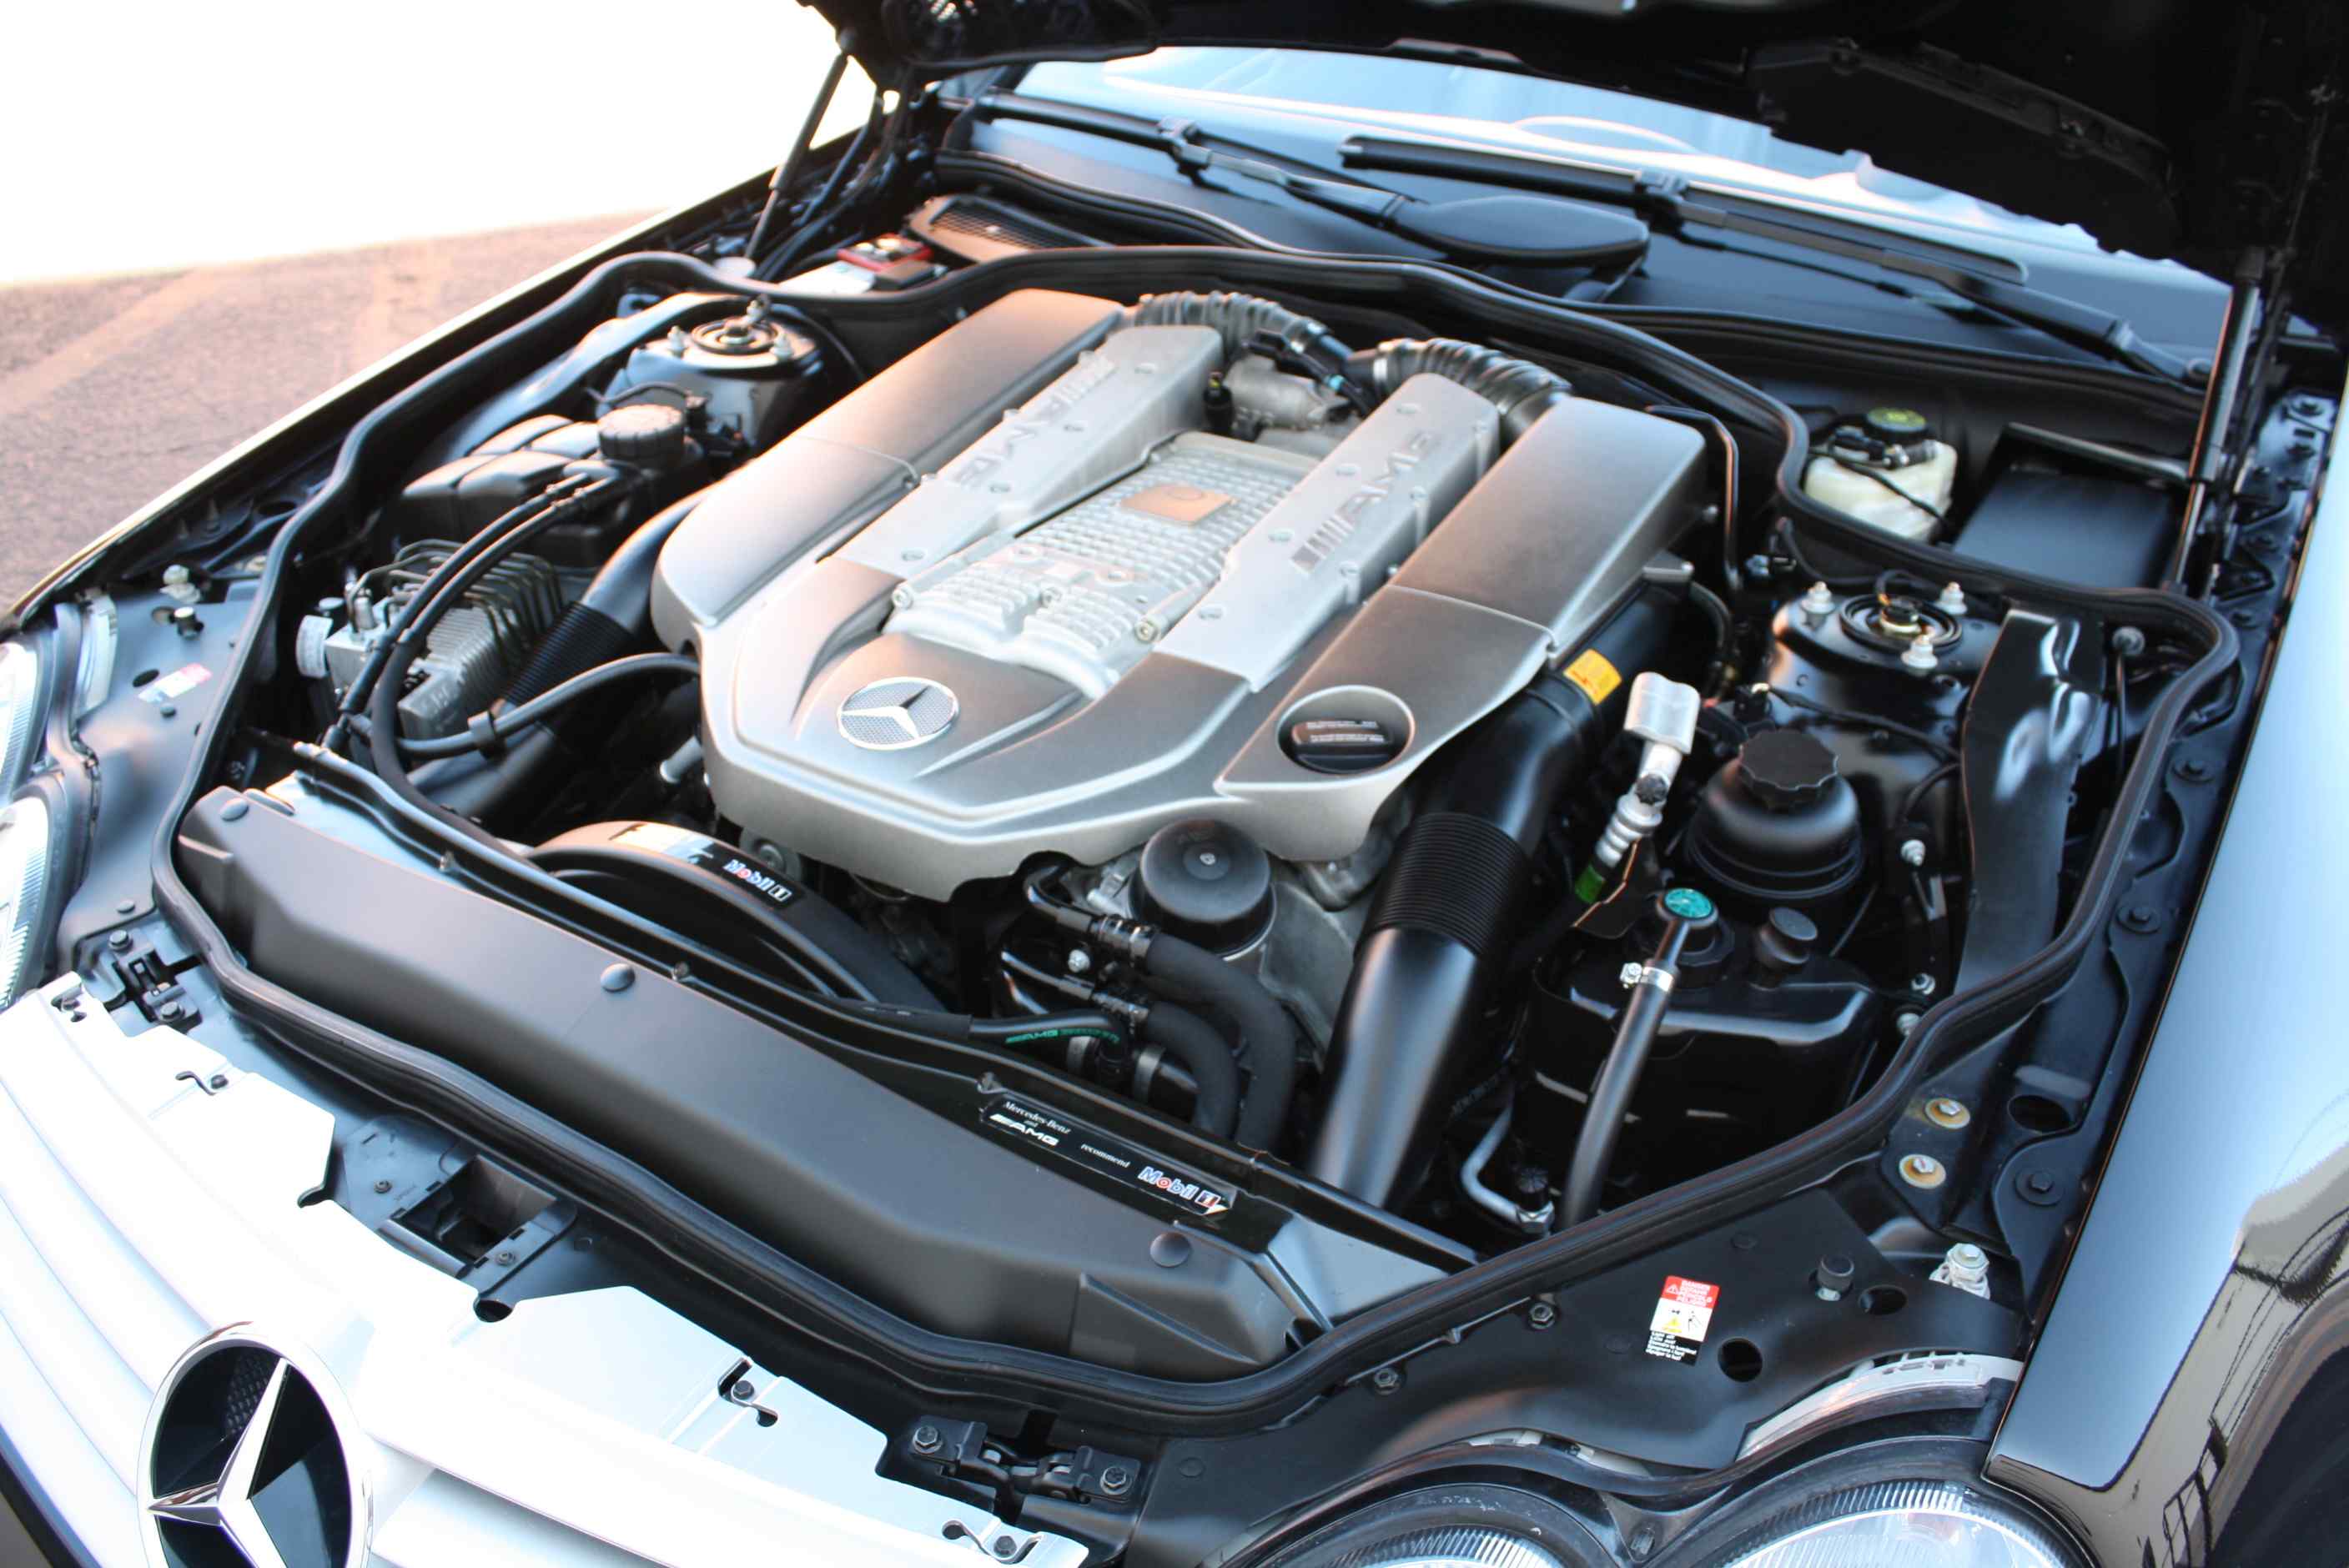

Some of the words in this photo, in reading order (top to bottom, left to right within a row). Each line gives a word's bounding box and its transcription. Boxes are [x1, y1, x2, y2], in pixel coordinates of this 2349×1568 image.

[722, 859, 775, 891] Mobil
[1003, 1101, 1072, 1134] Mercedes-Benz
[1005, 1120, 1059, 1146] AMG
[1080, 1143, 1131, 1168] recommend
[1137, 1166, 1200, 1200] Mobil
